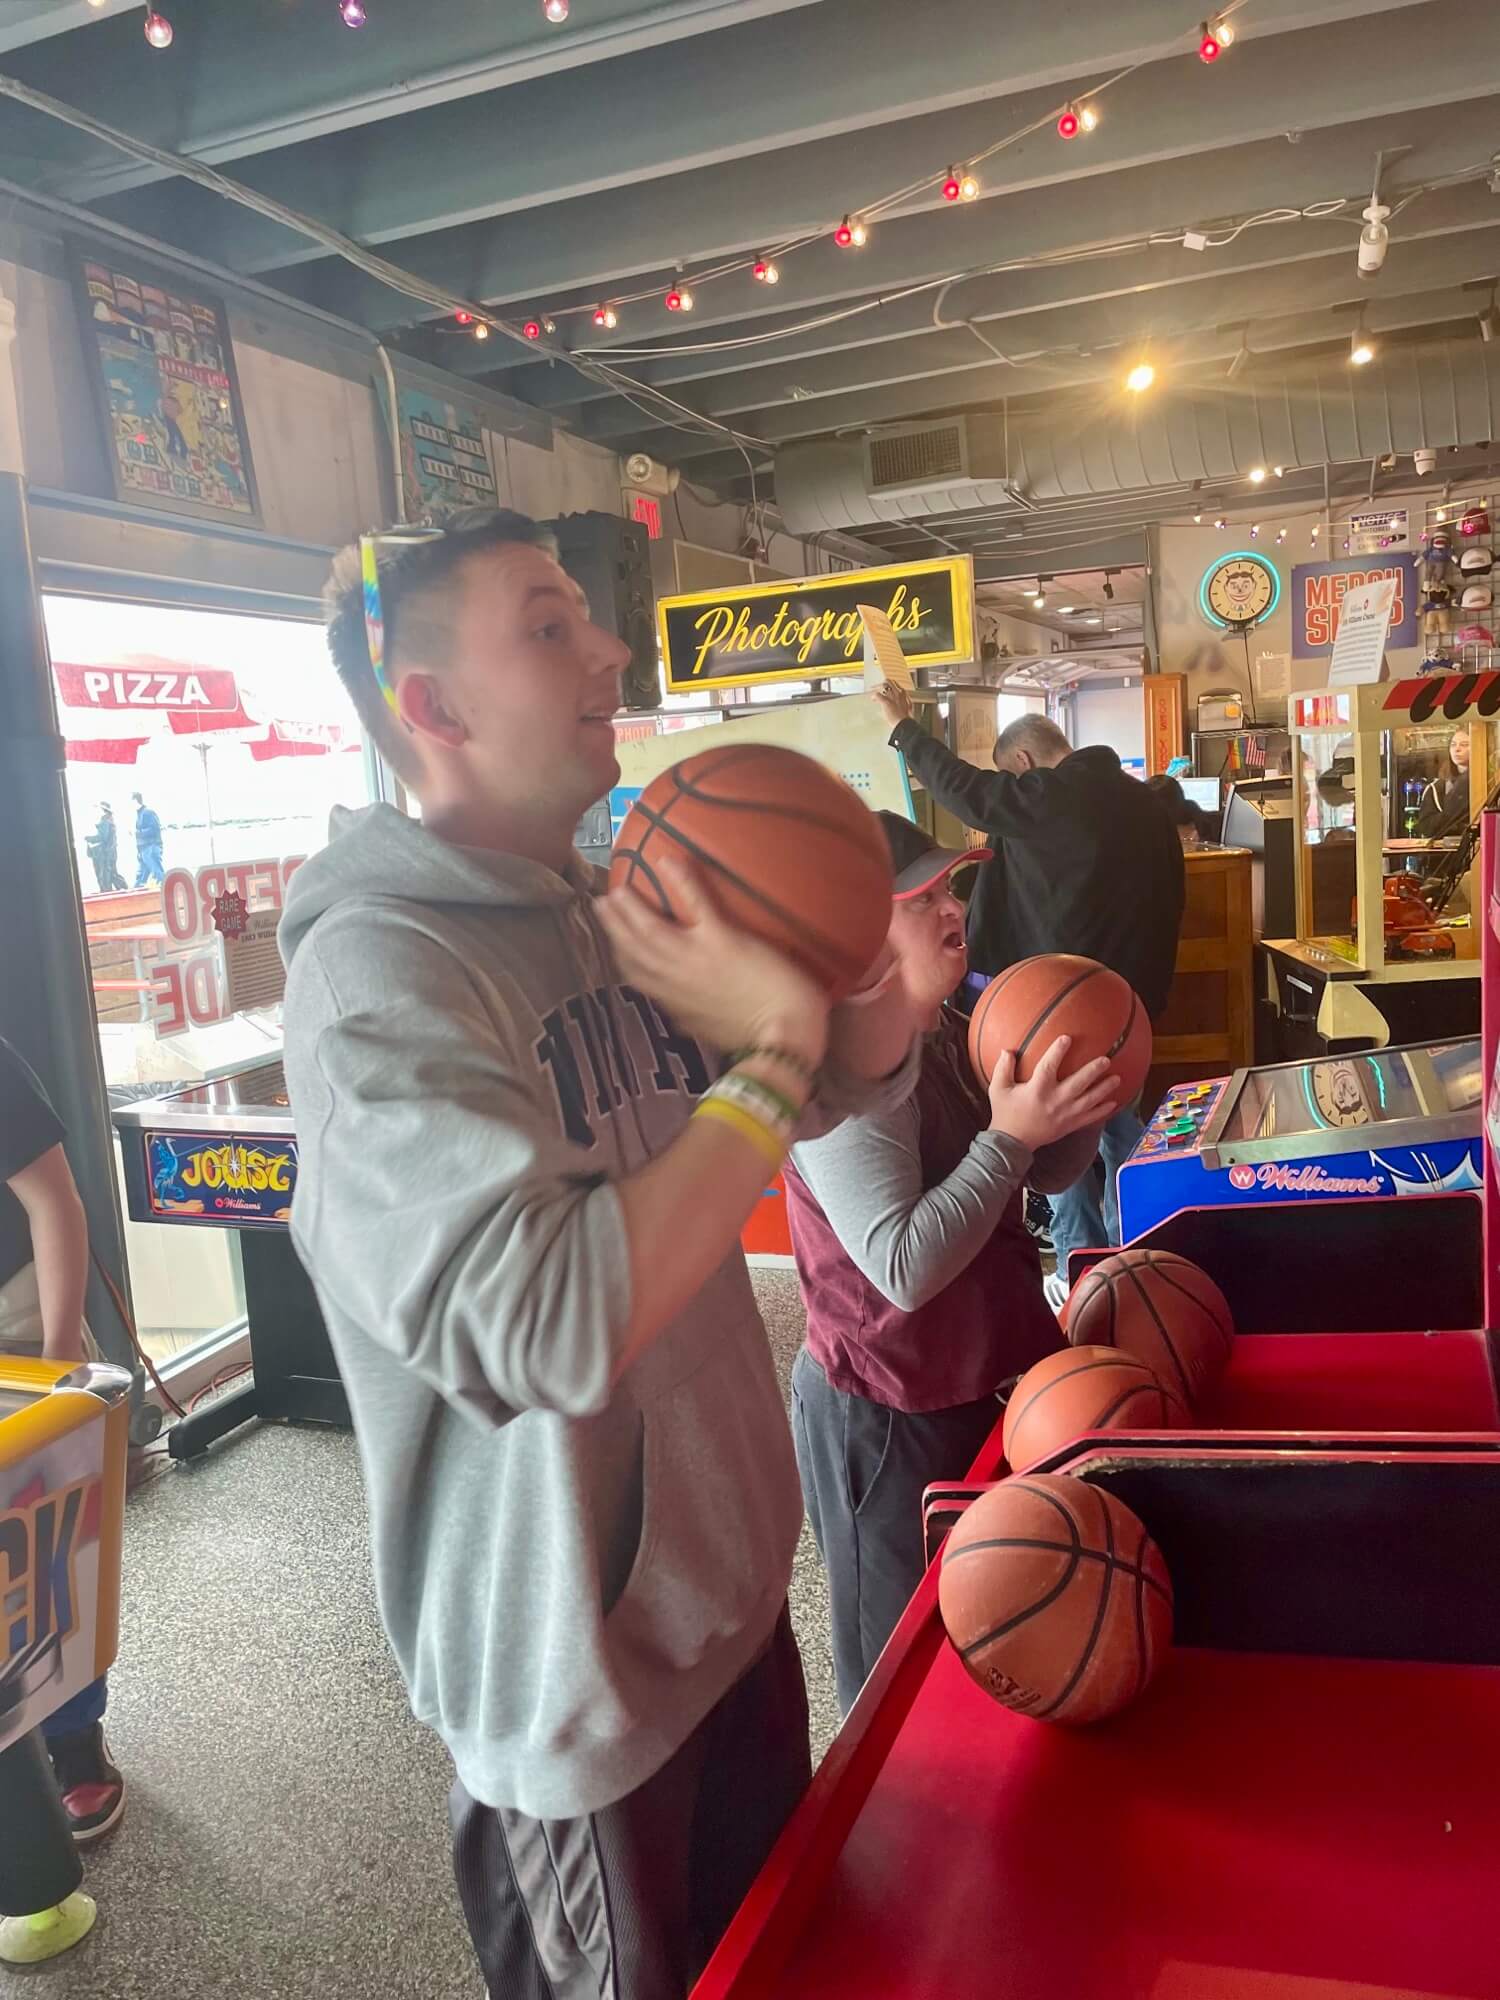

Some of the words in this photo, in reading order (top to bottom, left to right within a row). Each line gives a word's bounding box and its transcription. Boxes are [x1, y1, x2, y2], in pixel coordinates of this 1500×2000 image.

[1306, 599, 1404, 645] SP
[84, 671, 212, 705] PIZZA
[615, 726, 653, 743] PHOTO
[219, 898, 240, 913] RARE
[222, 915, 242, 931] GAME
[181, 1146, 290, 1191] JOUST
[1257, 1163, 1381, 1194] Williams
[223, 1197, 262, 1211] Williams
